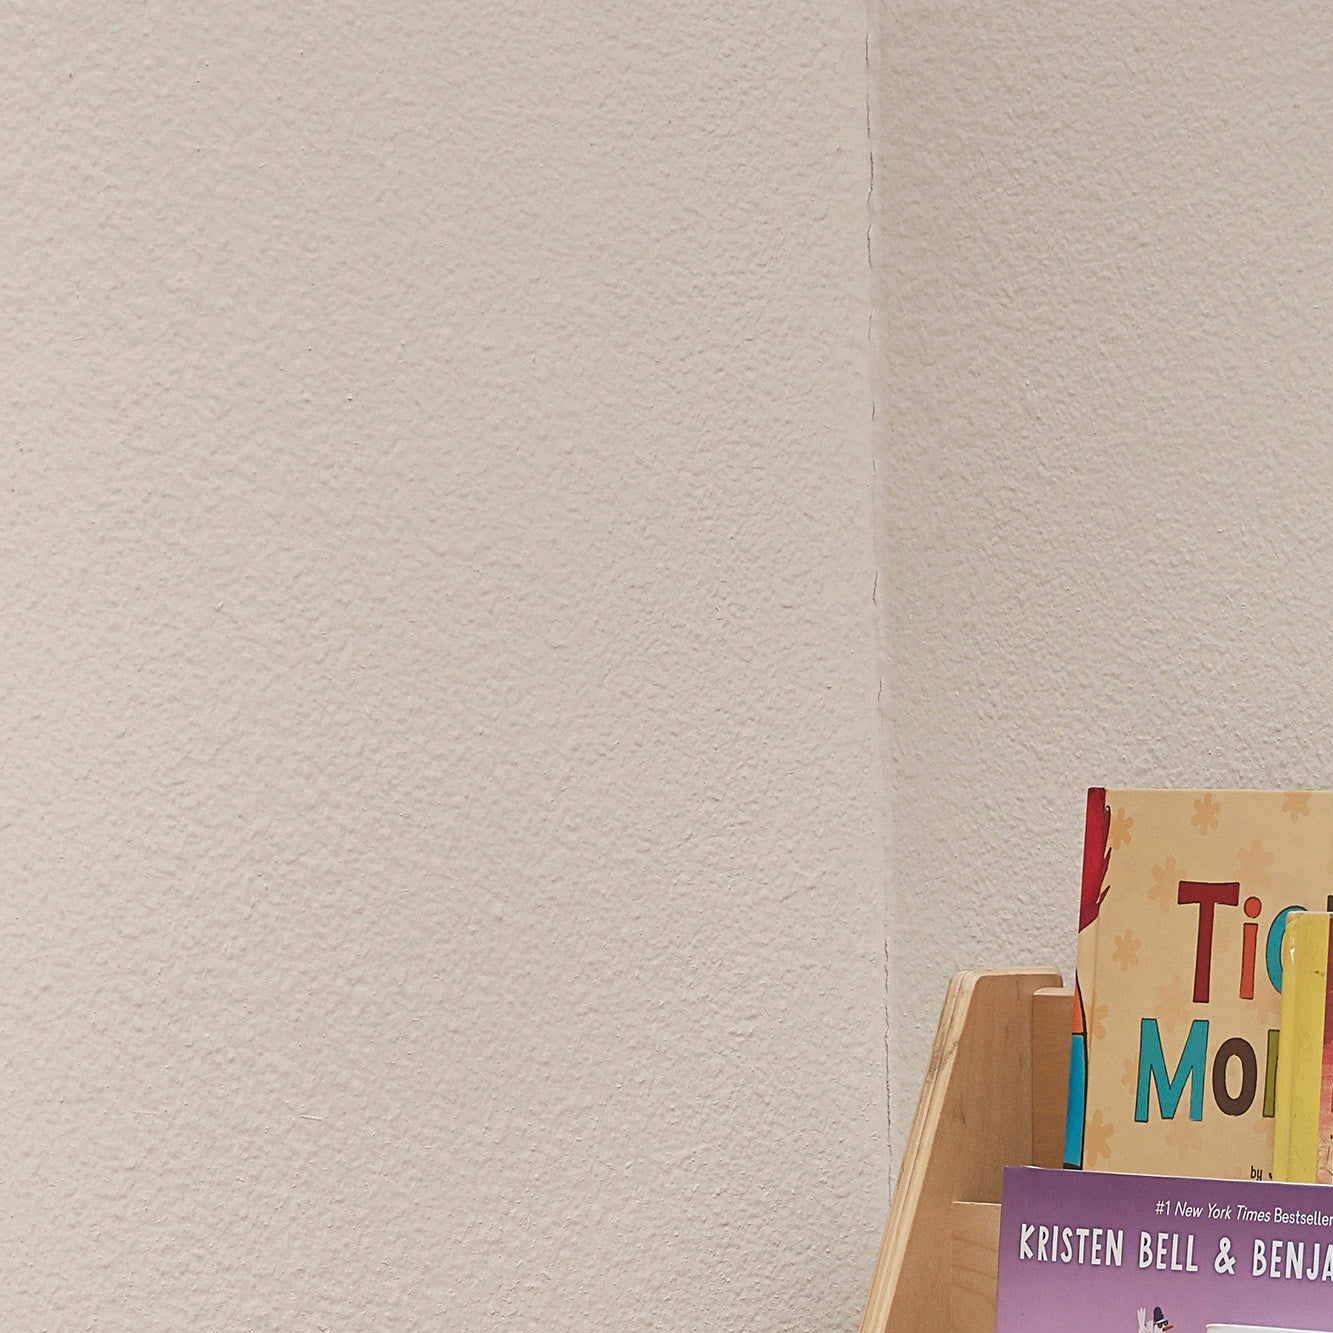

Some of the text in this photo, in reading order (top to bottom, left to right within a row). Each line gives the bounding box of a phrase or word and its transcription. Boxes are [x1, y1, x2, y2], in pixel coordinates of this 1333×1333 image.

[1155, 1201, 1171, 1216] #1
[1175, 1201, 1202, 1218] New
[1207, 1203, 1232, 1220] York
[1236, 1204, 1271, 1222] Times
[1018, 1223, 1124, 1268] KRISTEN
[1139, 1231, 1198, 1273] BELL
[1214, 1237, 1236, 1275] &
